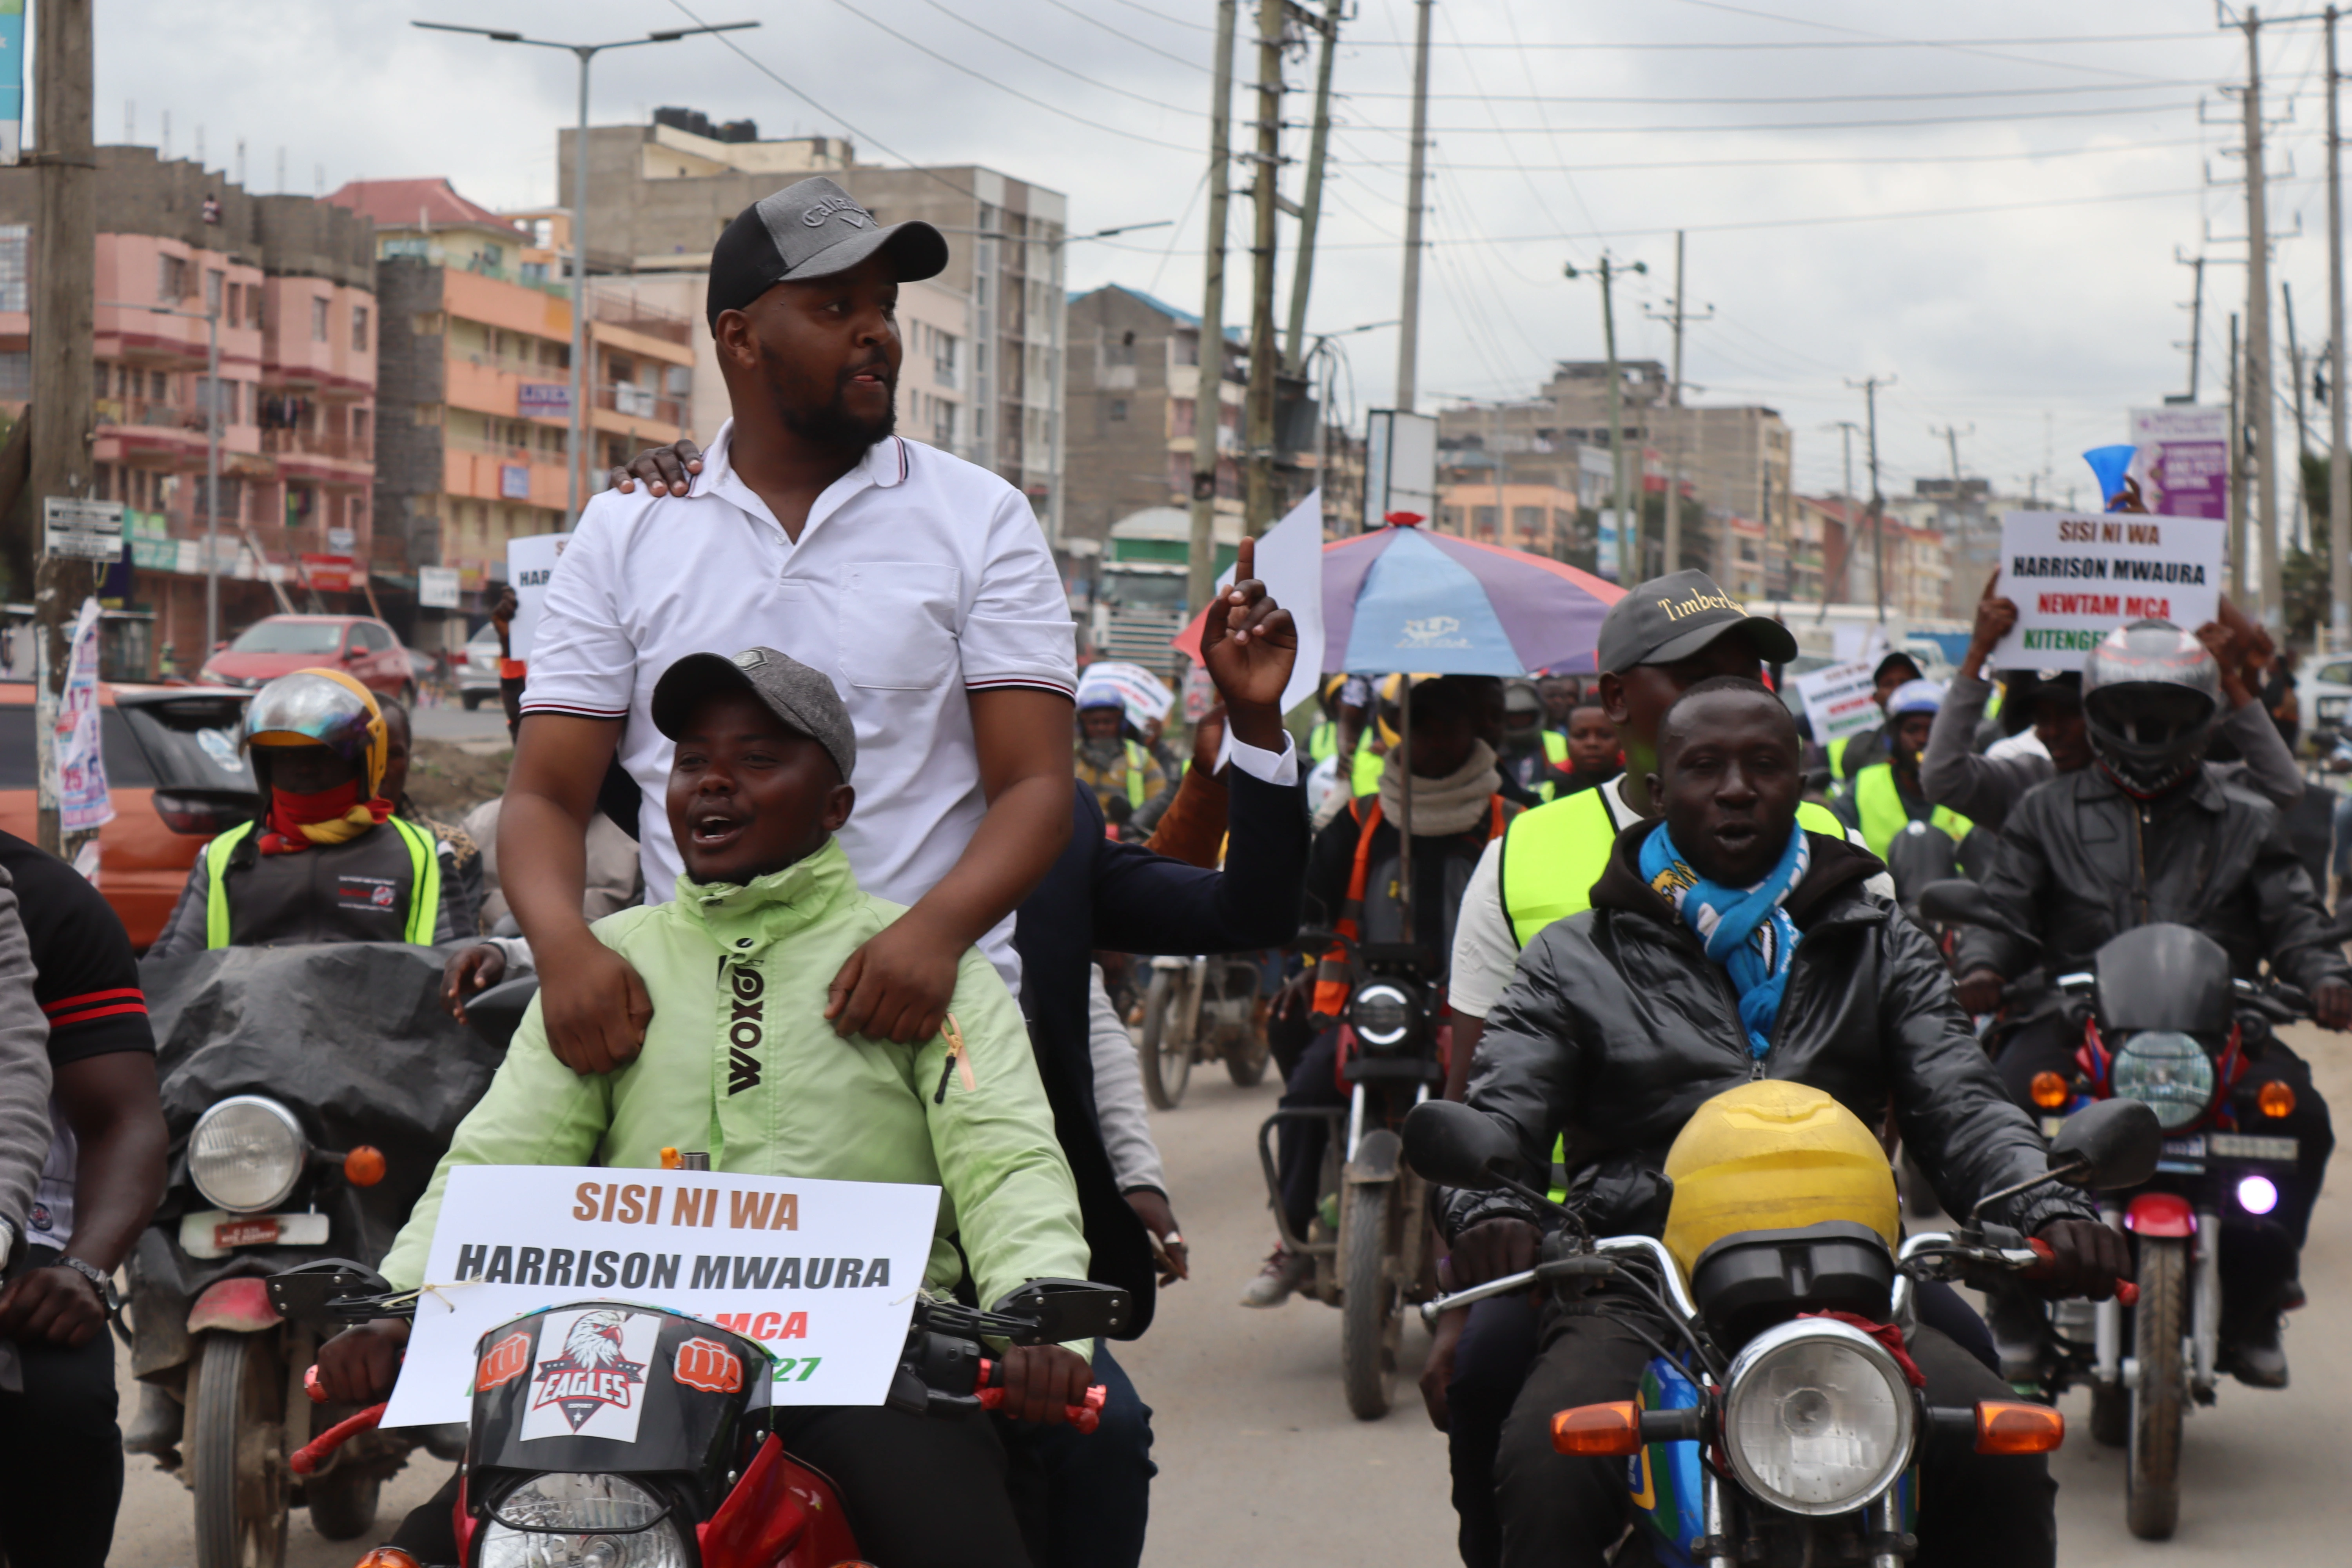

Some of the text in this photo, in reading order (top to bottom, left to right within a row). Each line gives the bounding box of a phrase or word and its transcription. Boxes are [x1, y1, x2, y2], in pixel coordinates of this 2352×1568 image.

[2059, 521, 2160, 545] SISI NI WA
[2013, 556, 2206, 586] HARRISON MWAURA
[1657, 587, 1749, 621] Timberl
[2037, 593, 2120, 616] NEWTAM
[2024, 629, 2109, 651] KITENGE
[573, 1182, 799, 1231] SISI NI WA
[455, 1244, 891, 1290] HARRISON MWAURA
[537, 1372, 629, 1406] EAGLES
